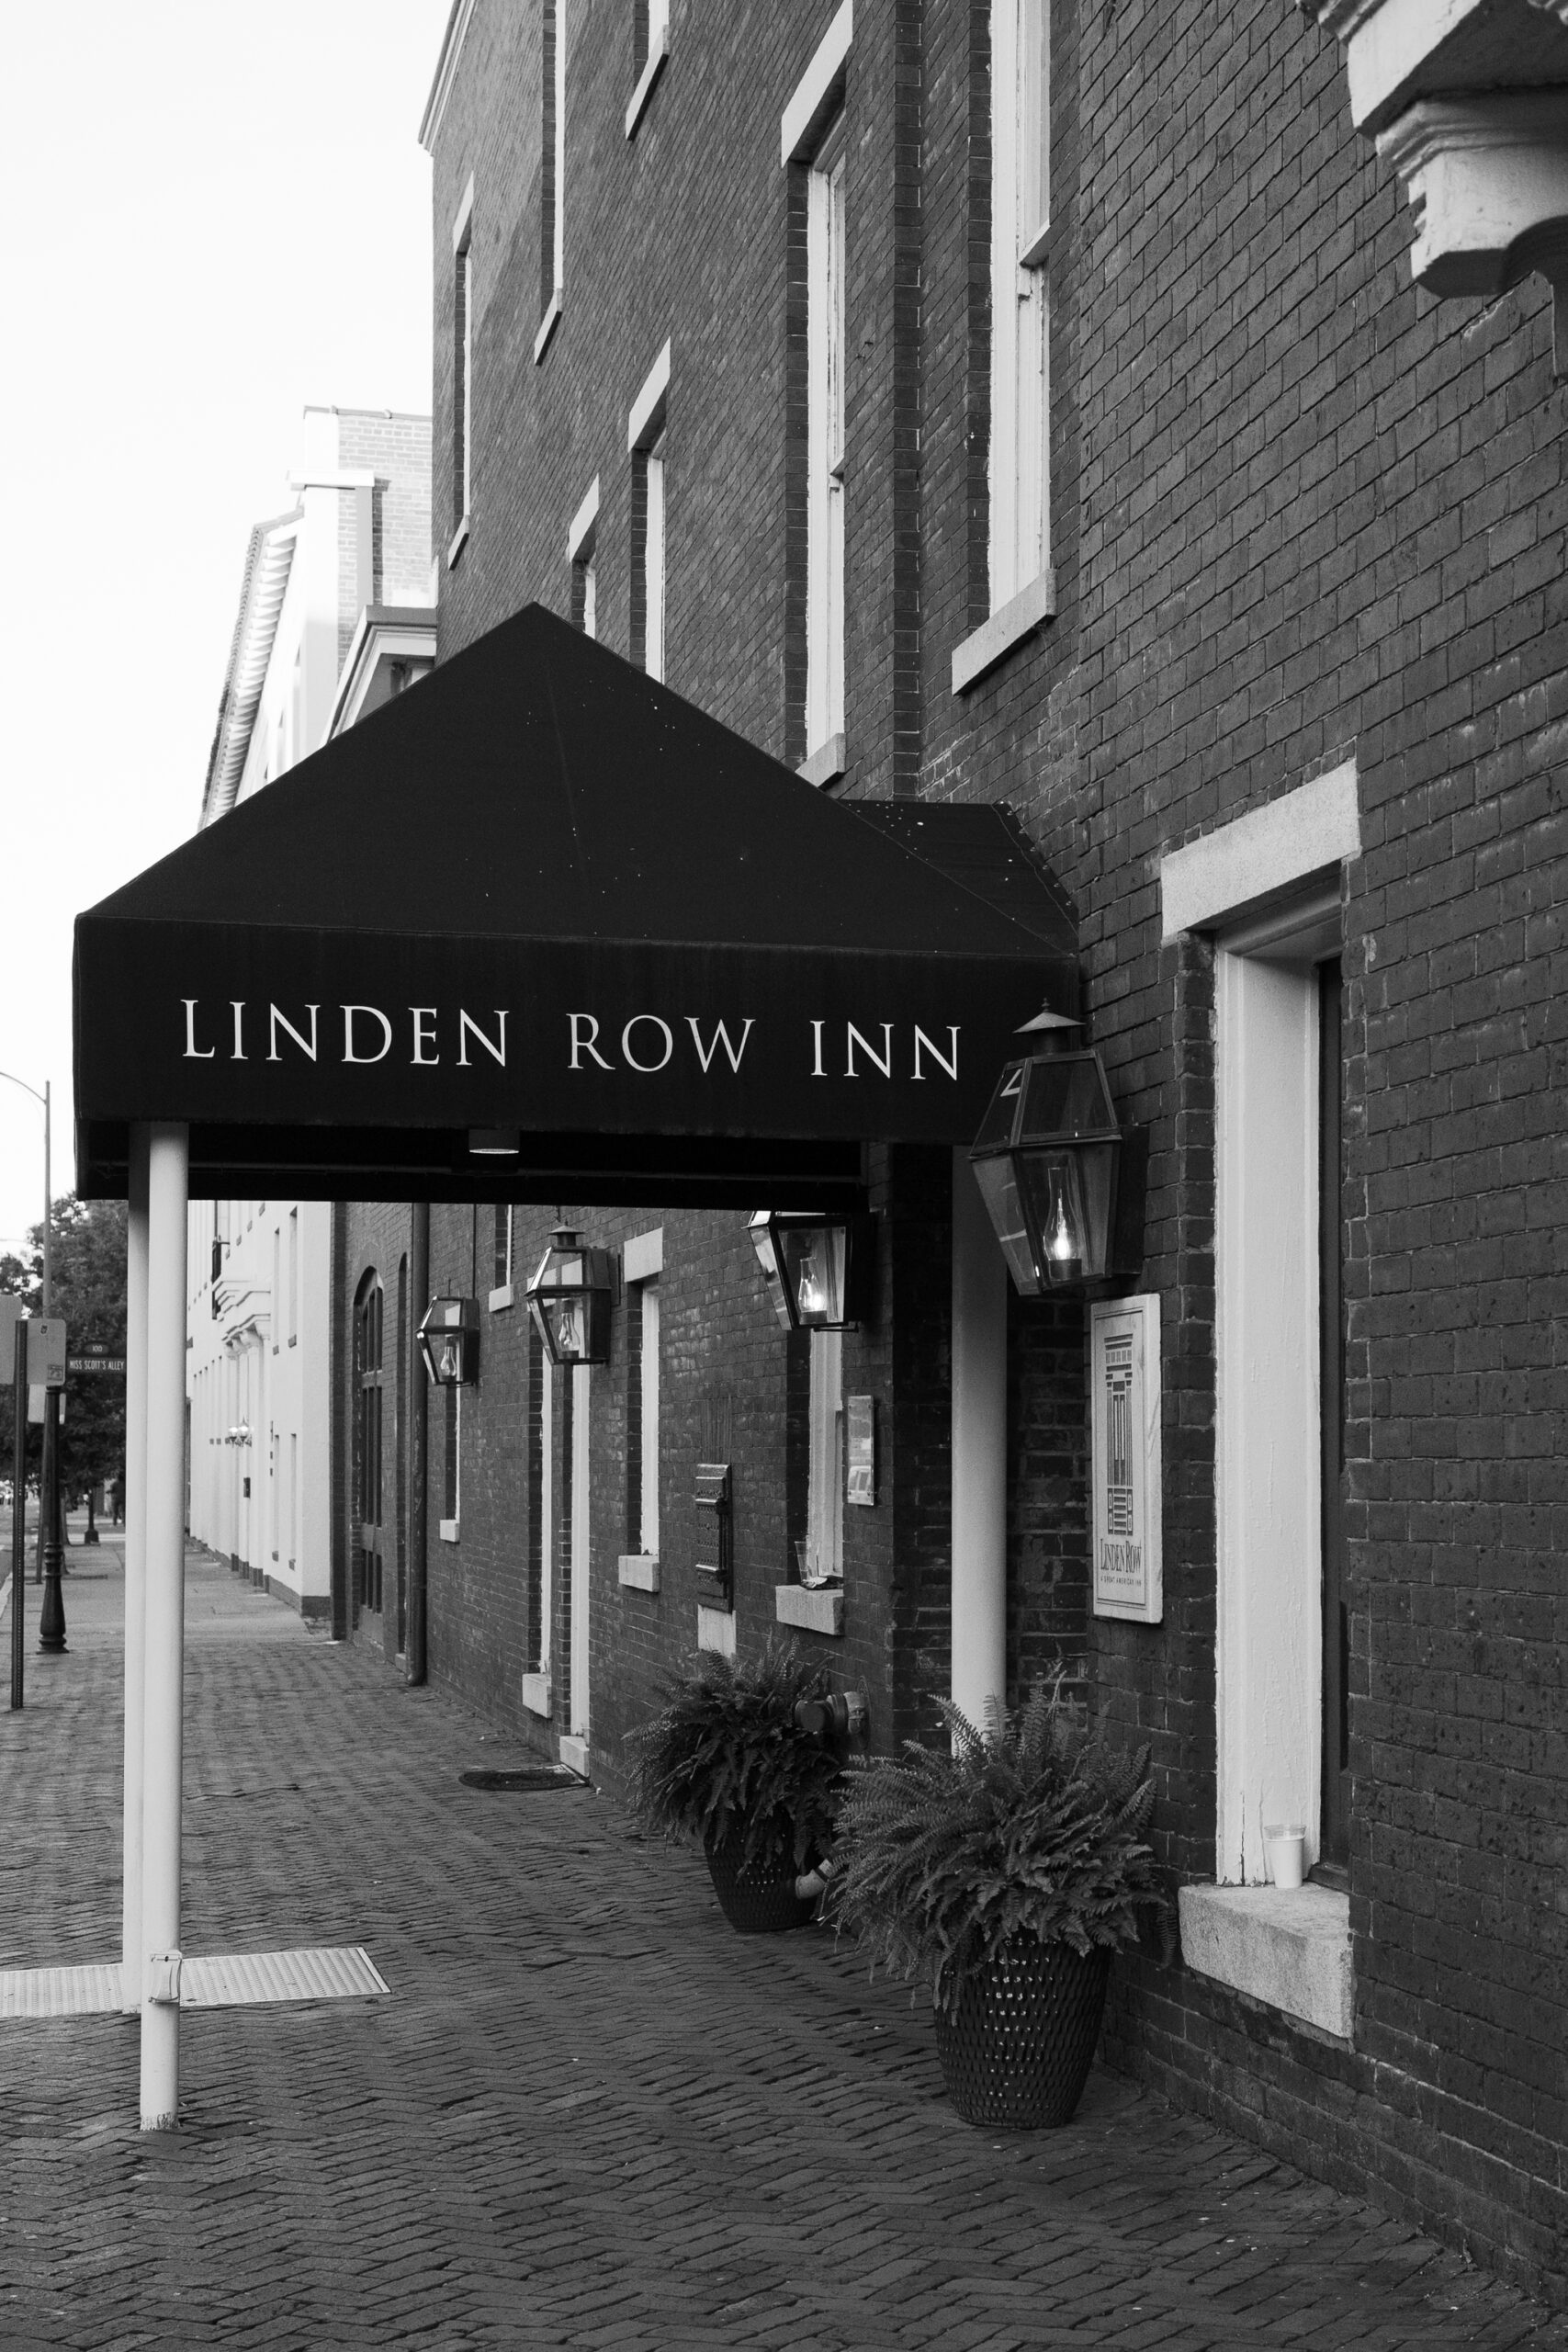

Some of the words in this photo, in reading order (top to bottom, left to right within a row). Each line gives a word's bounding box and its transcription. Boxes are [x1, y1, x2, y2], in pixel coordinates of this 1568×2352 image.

[180, 999, 510, 1068] LINDEN
[566, 1013, 756, 1073] ROW
[810, 1020, 961, 1081] INN
[69, 1360, 82, 1370] MISS
[84, 1360, 106, 1370] SCOTT'S
[107, 1361, 125, 1371] ALLEY
[1100, 1538, 1125, 1572] LINDEN
[1125, 1540, 1142, 1573] ROW
